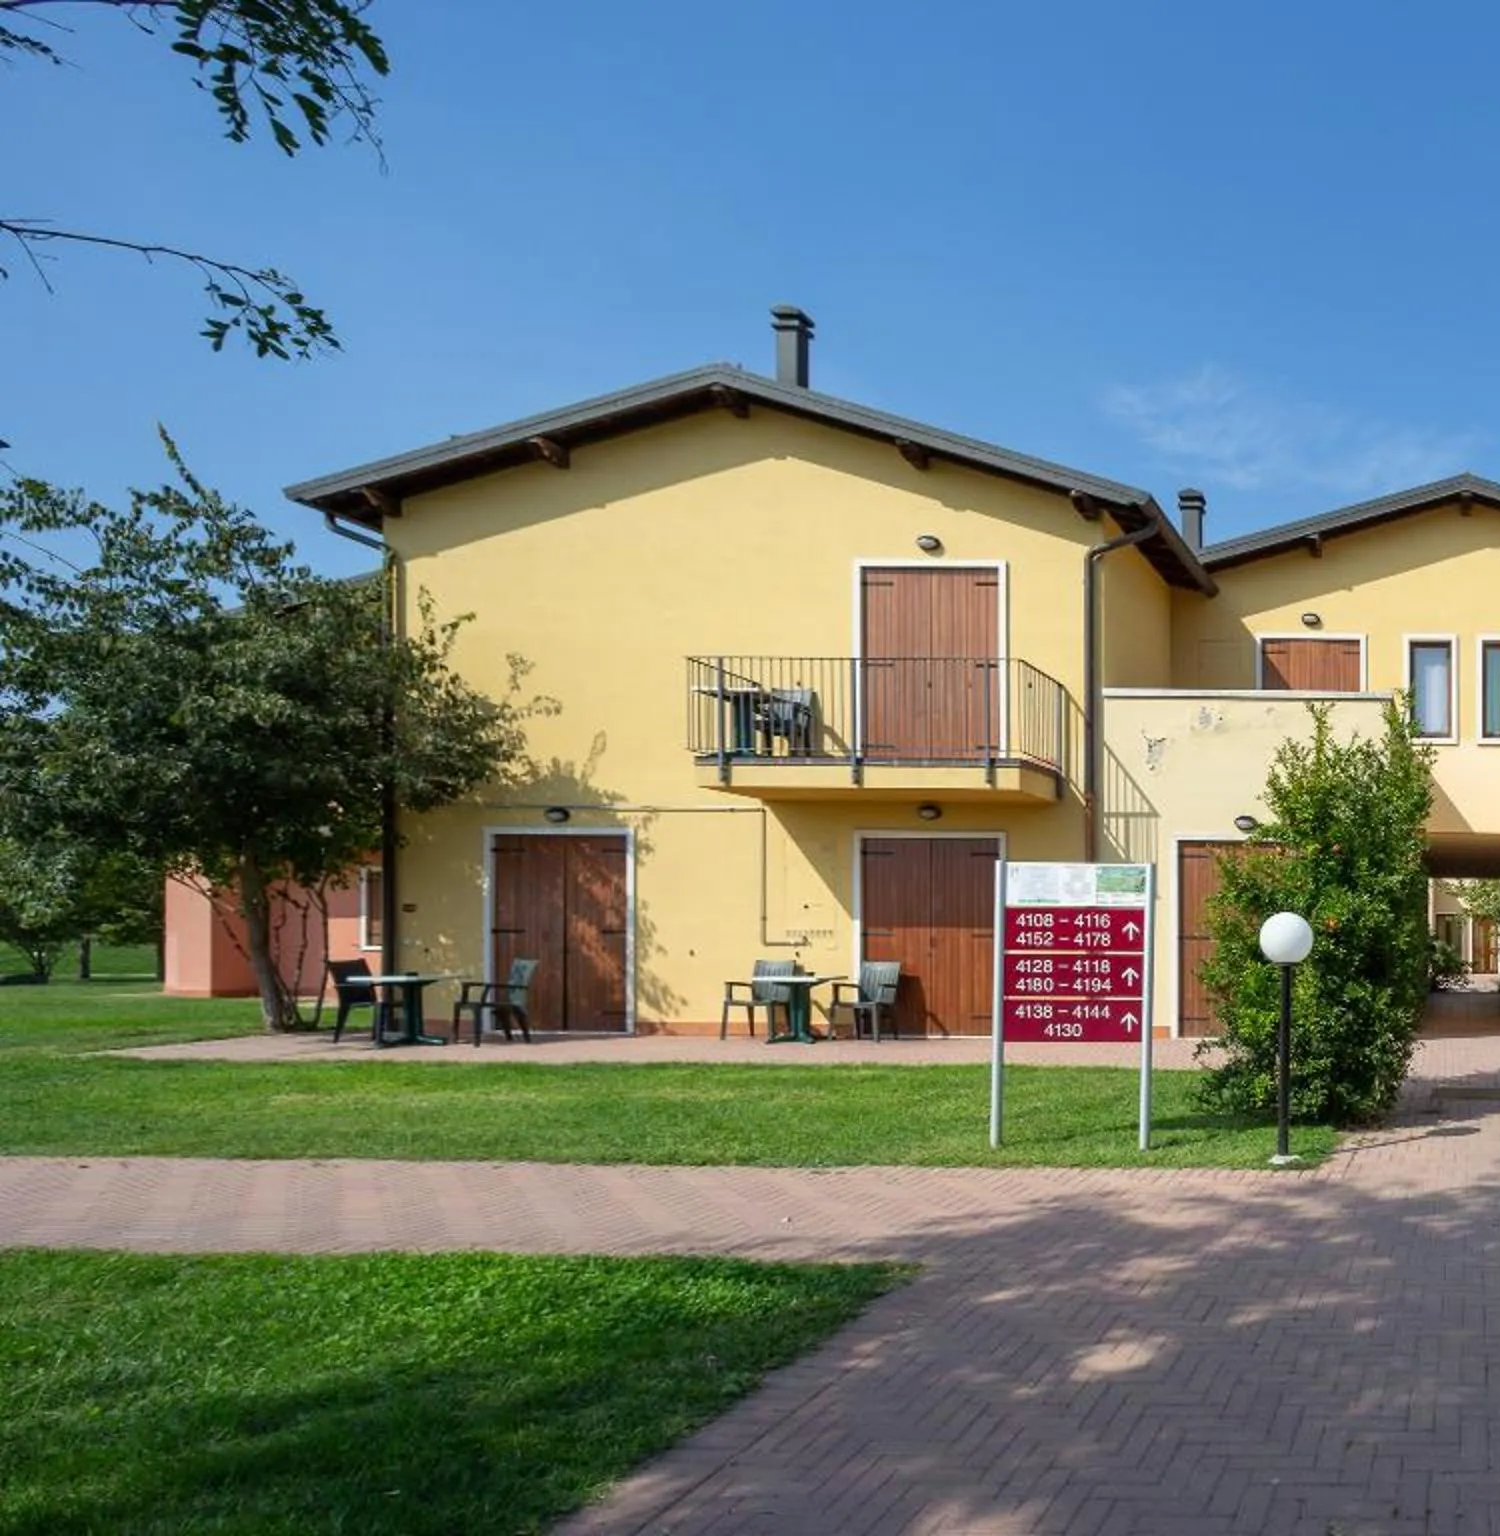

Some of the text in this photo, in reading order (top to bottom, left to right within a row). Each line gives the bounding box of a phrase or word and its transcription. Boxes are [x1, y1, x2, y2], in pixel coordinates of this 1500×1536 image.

[1015, 913, 1055, 927] 4108
[1073, 913, 1111, 929] 4116
[1015, 931, 1055, 946] 4152
[1073, 931, 1111, 947] 4178
[1015, 959, 1053, 974] 4128
[1072, 959, 1111, 974] 4118
[1015, 977, 1054, 992] 4180
[1072, 977, 1112, 993] 4194
[1015, 1004, 1053, 1019] 4138
[1072, 1004, 1110, 1019] 4144
[1043, 1022, 1083, 1037] 4130
